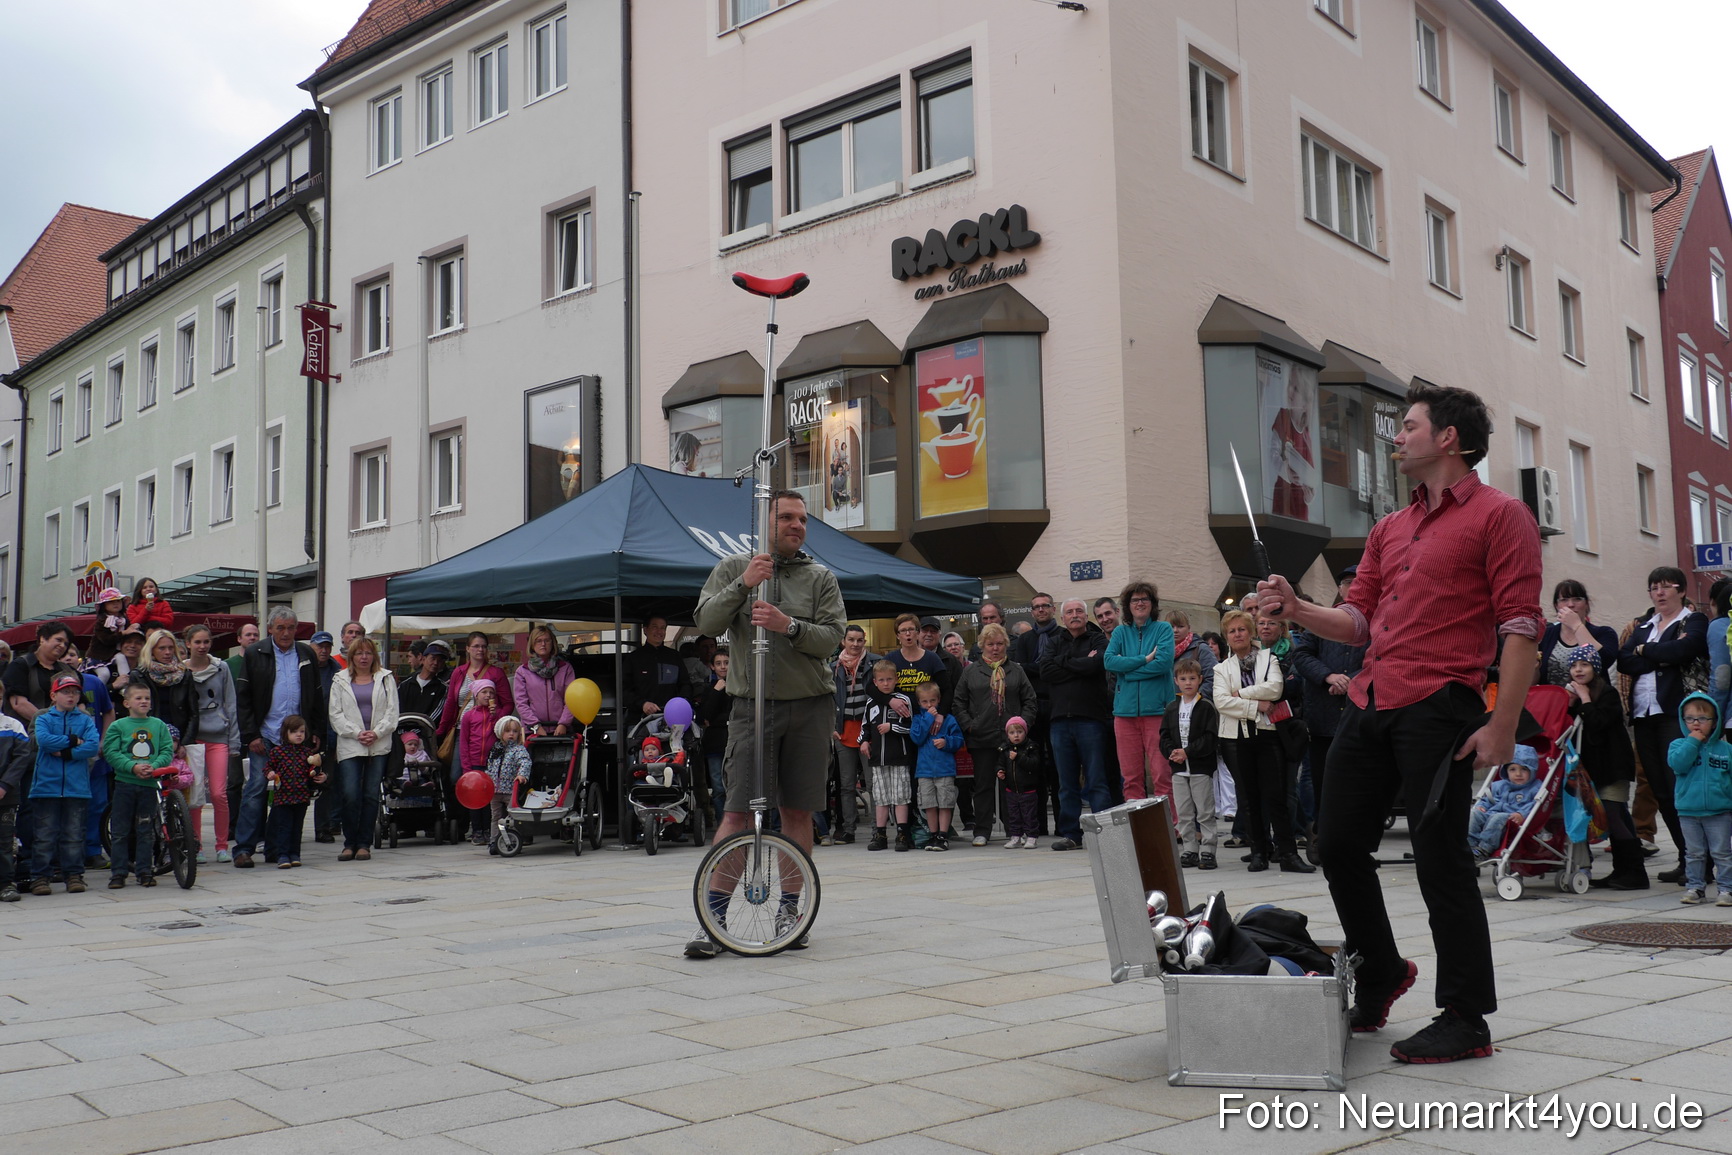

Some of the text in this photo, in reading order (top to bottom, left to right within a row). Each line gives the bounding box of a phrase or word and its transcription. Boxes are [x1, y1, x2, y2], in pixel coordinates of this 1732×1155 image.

[891, 203, 1041, 281] RACKL
[914, 258, 1027, 301] am Rathaus
[306, 317, 325, 374] Achatz
[793, 378, 834, 400] 100 Jahre
[687, 525, 759, 558] RAC
[77, 569, 114, 607] RENO
[203, 616, 234, 630] Achatz
